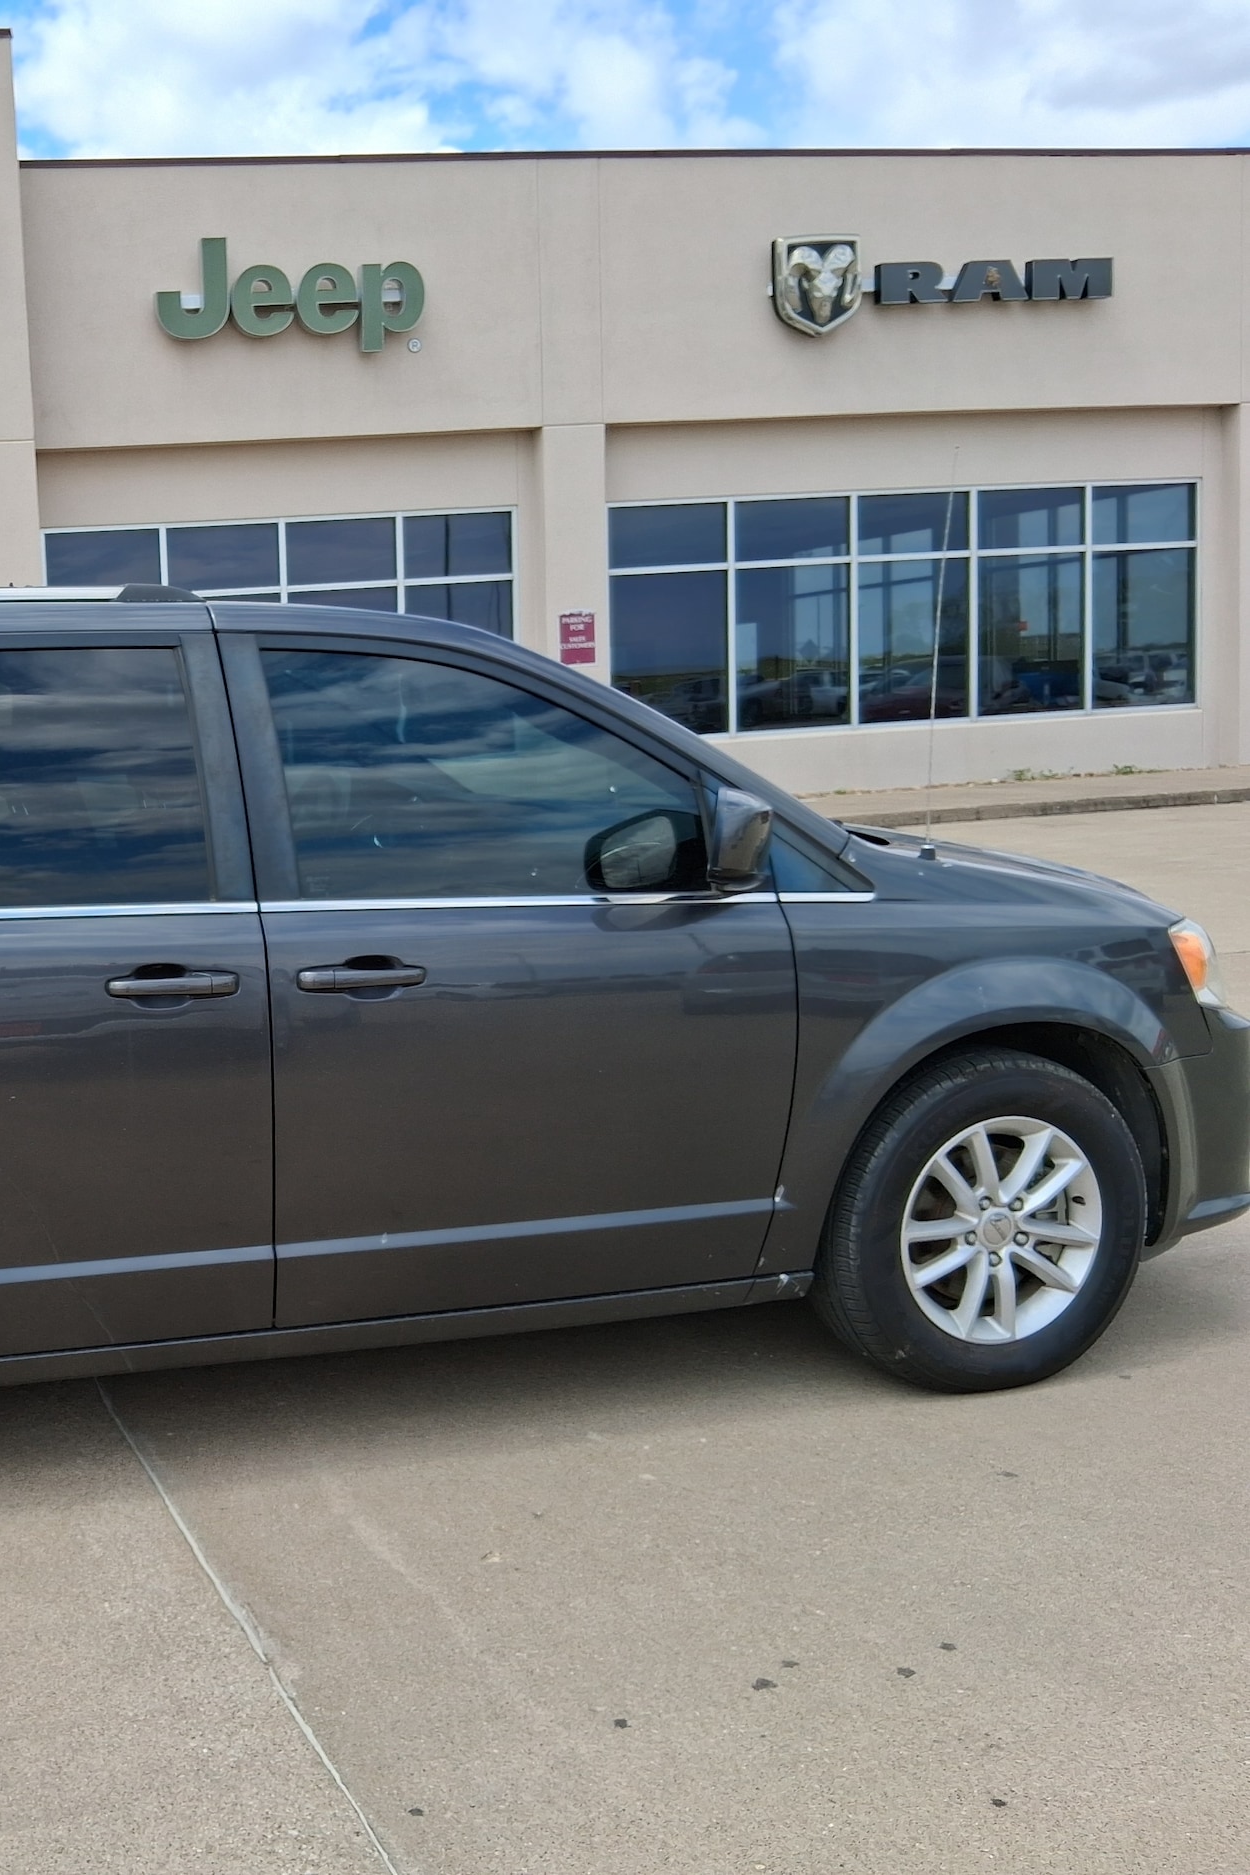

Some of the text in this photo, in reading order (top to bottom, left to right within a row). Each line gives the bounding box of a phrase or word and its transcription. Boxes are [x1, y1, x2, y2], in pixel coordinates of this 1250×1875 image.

[875, 257, 1114, 304] RAM
[155, 237, 425, 353] Jeep
[561, 616, 593, 624] PARKING
[569, 624, 585, 632] FOR
[560, 642, 596, 650] CUSTOMERS
